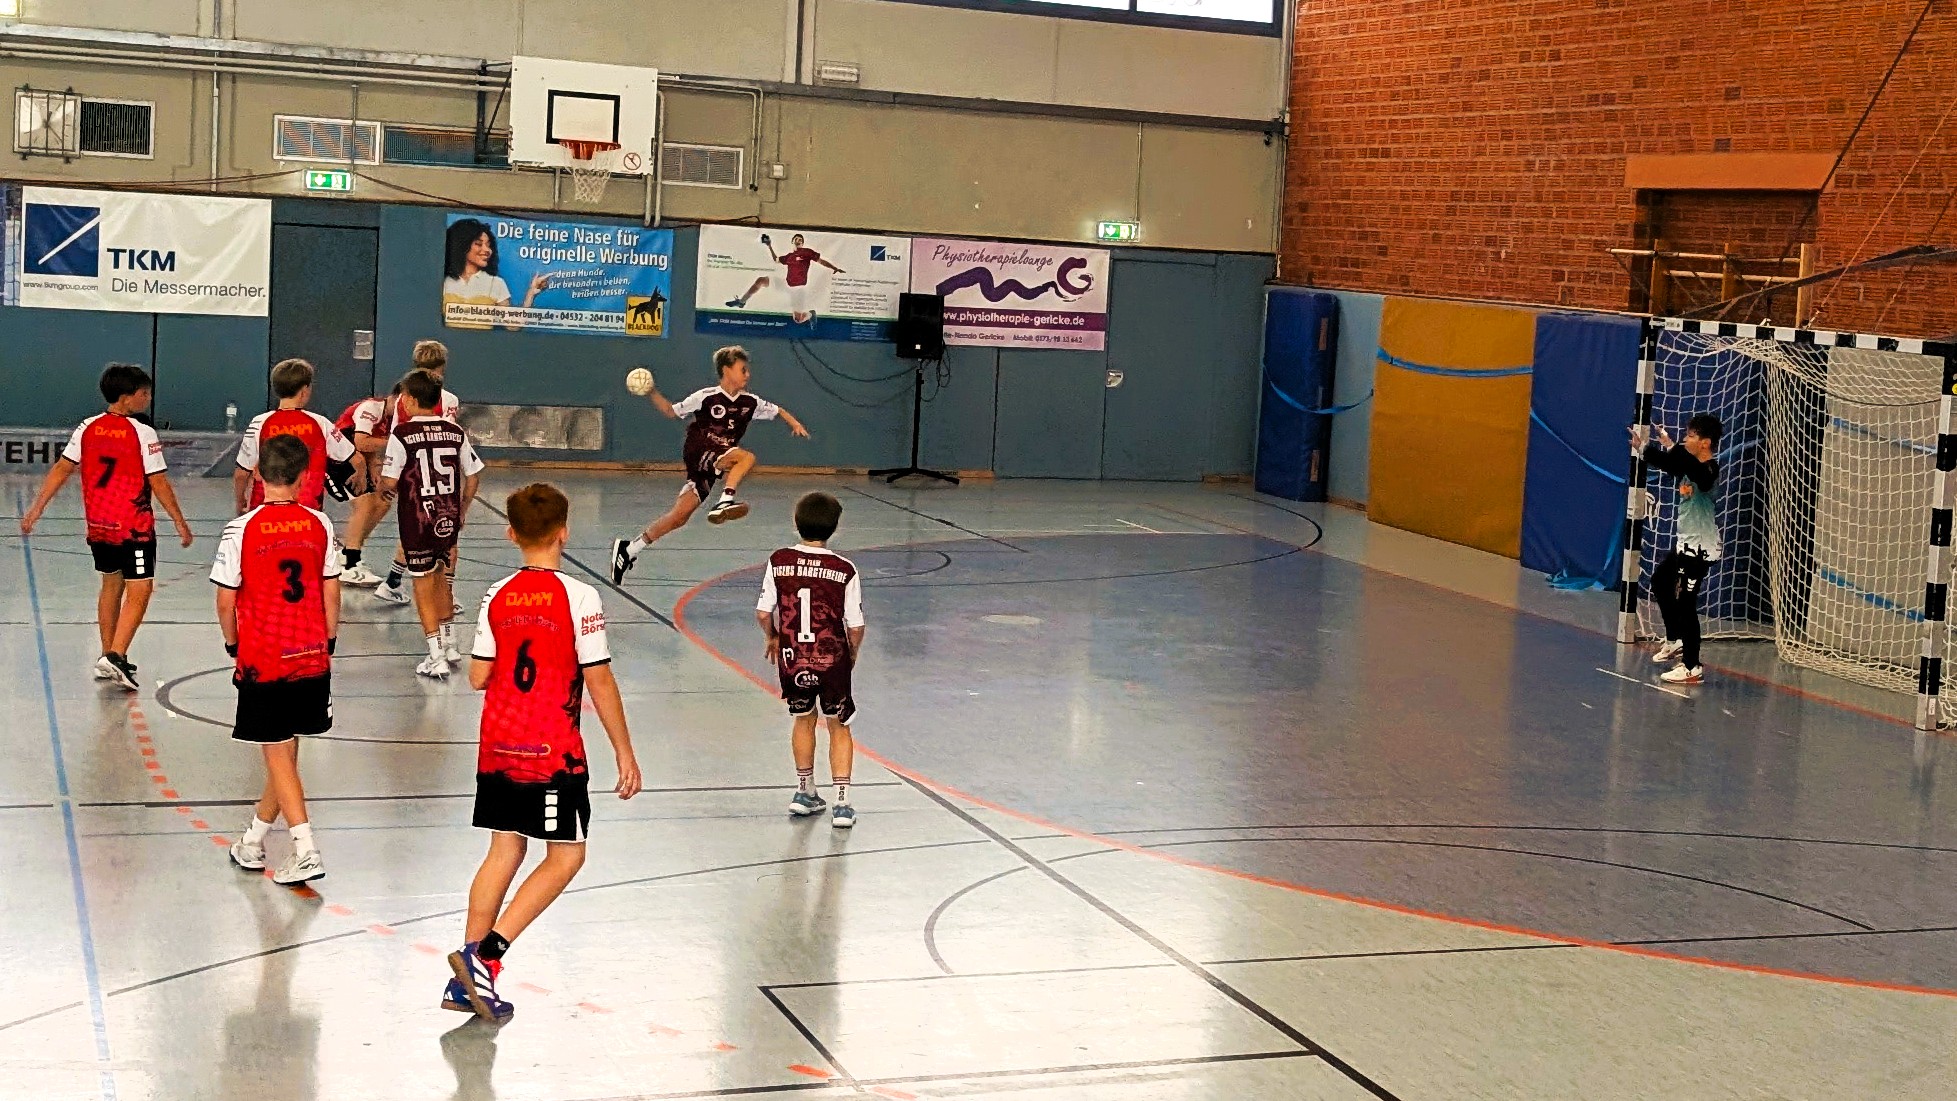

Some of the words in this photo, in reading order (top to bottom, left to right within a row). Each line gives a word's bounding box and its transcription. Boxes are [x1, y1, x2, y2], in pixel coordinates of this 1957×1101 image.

[497, 222, 523, 239] Die
[529, 224, 569, 243] feine
[573, 228, 612, 246] Nase
[616, 230, 640, 247] für
[106, 248, 176, 272] TKM
[519, 244, 595, 265] originelle
[599, 248, 668, 271] Werbung
[932, 244, 1054, 272] Physiotherapielounge
[112, 277, 138, 293] Die
[143, 279, 266, 298] Messermacher.
[560, 311, 583, 321] 04532
[943, 311, 1085, 327] ww.physiotherapie-gericke.de
[95, 456, 117, 489] 7
[416, 447, 457, 496] 15
[260, 519, 311, 534] DAMM
[279, 559, 305, 603] 3
[505, 591, 553, 606] DAMM
[581, 612, 605, 624] Nota
[797, 587, 816, 643] 1
[514, 639, 537, 693] 6
